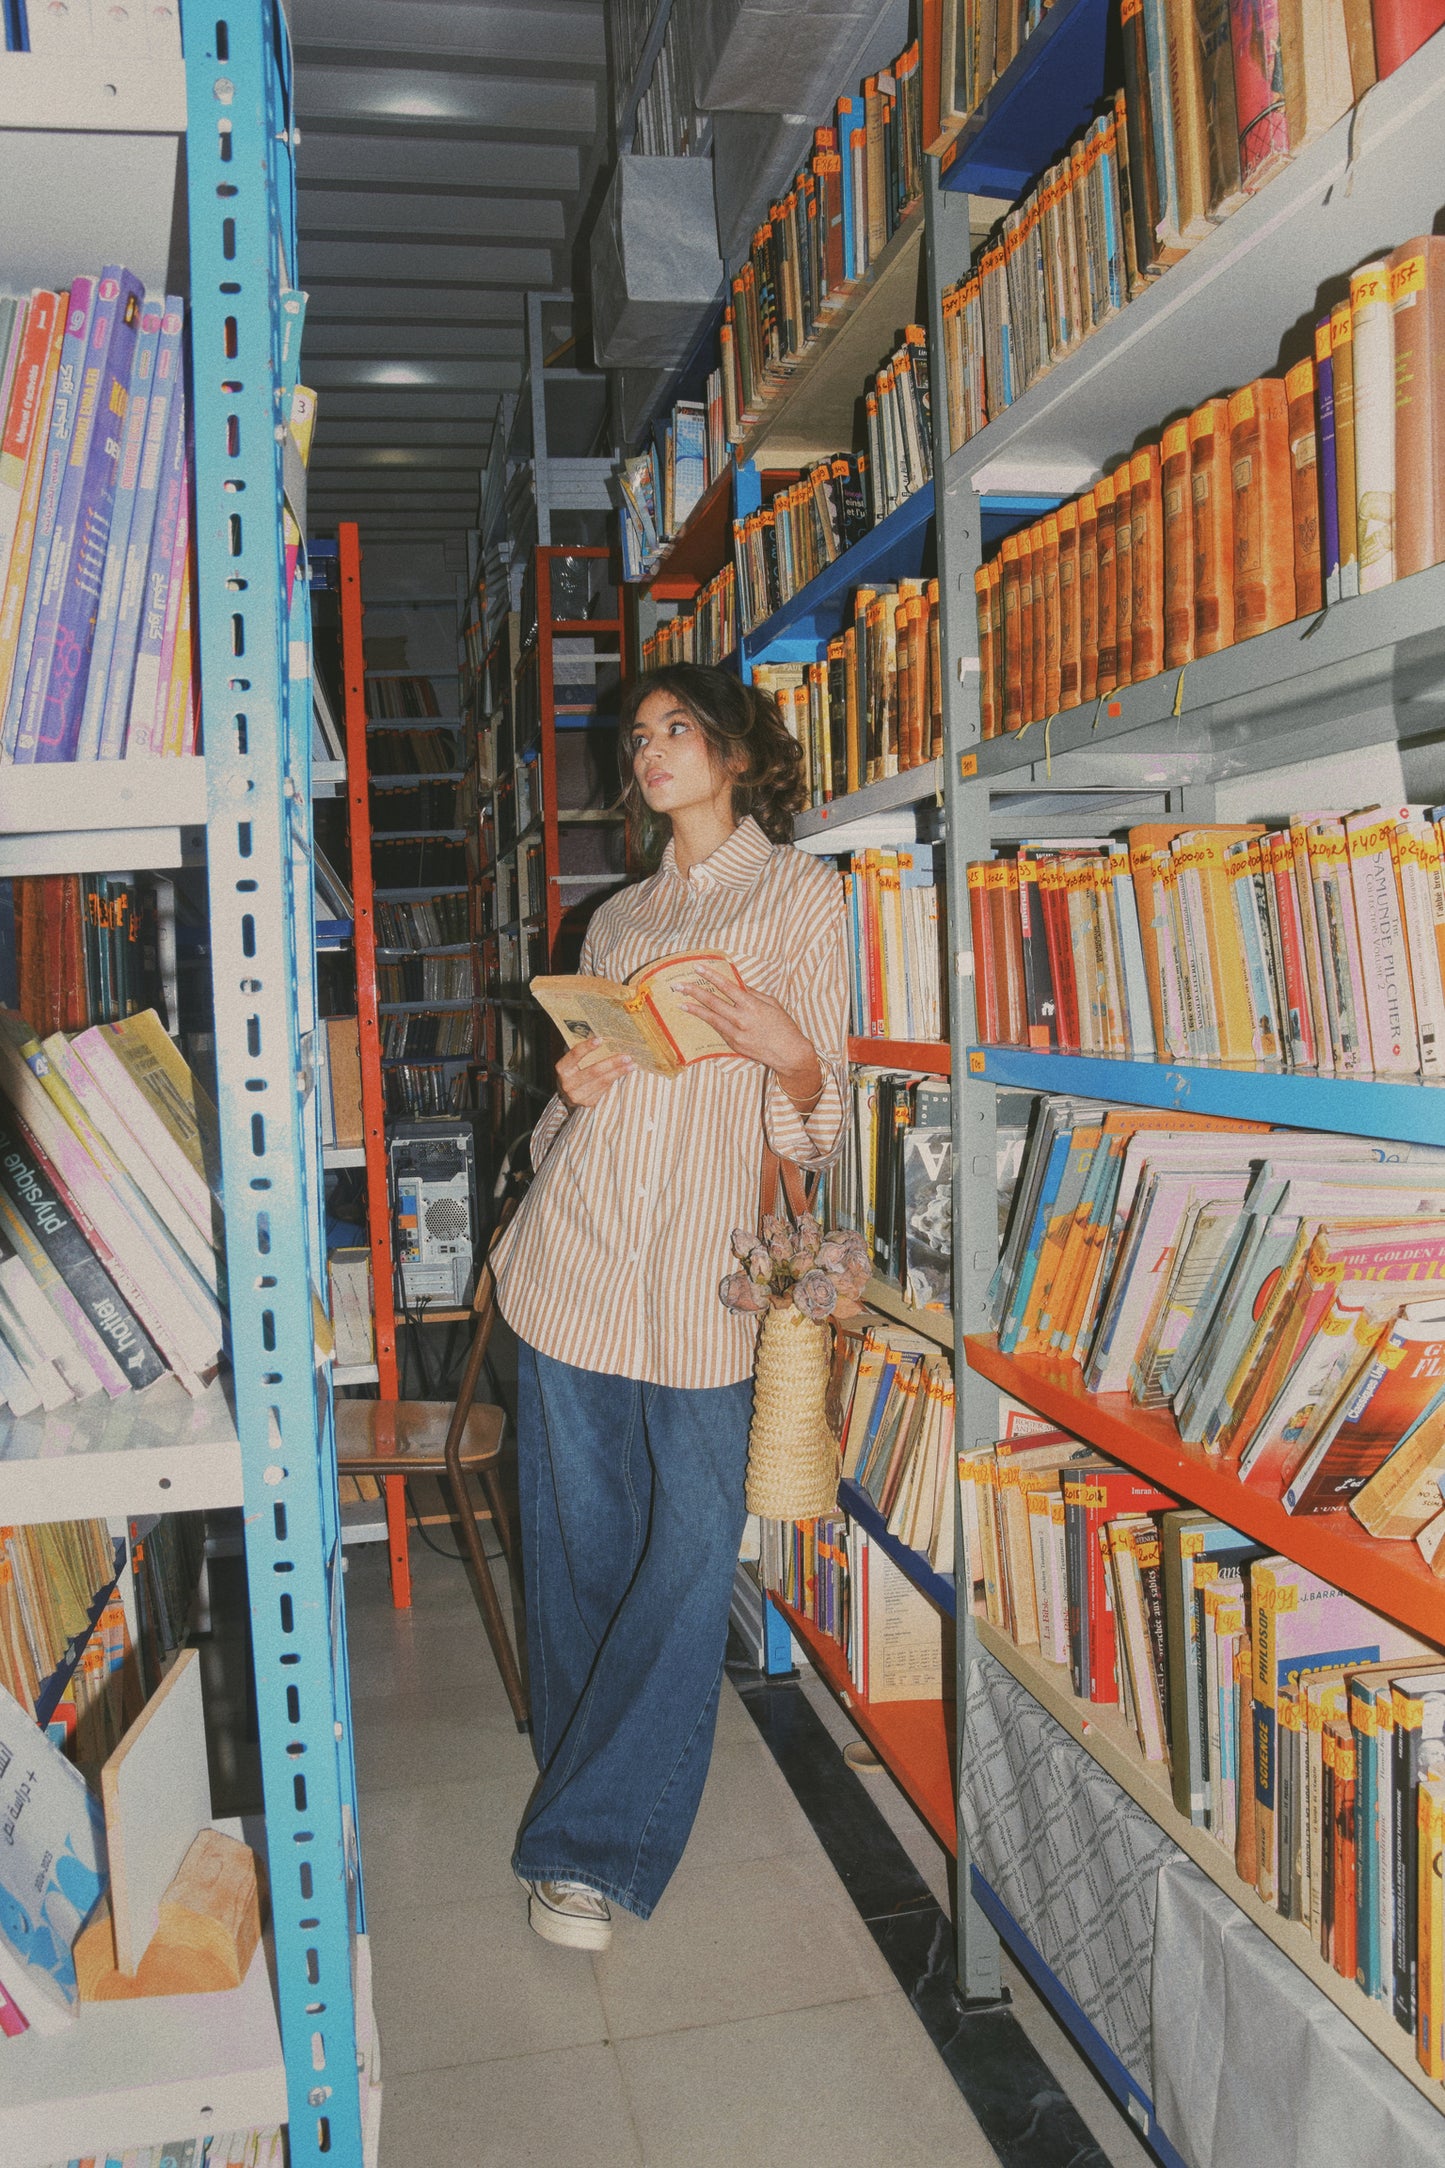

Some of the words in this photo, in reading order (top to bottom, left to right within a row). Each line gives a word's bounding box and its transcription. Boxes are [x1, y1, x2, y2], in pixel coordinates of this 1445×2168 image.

[1383, 955, 1402, 1039] PILCHER
[3, 1152, 67, 1236] physique
[1373, 1247, 1433, 1263] GOLDEN
[91, 1297, 137, 1351] hatier
[1346, 1377, 1380, 1422] Classiques
[1131, 1486, 1152, 1495] Imran
[1037, 1537, 1047, 1569] Testament
[1147, 1570, 1159, 1598] sables
[1041, 1598, 1051, 1623] Bible
[1153, 1601, 1162, 1617] aux
[1258, 1721, 1270, 1790] SCIENCE
